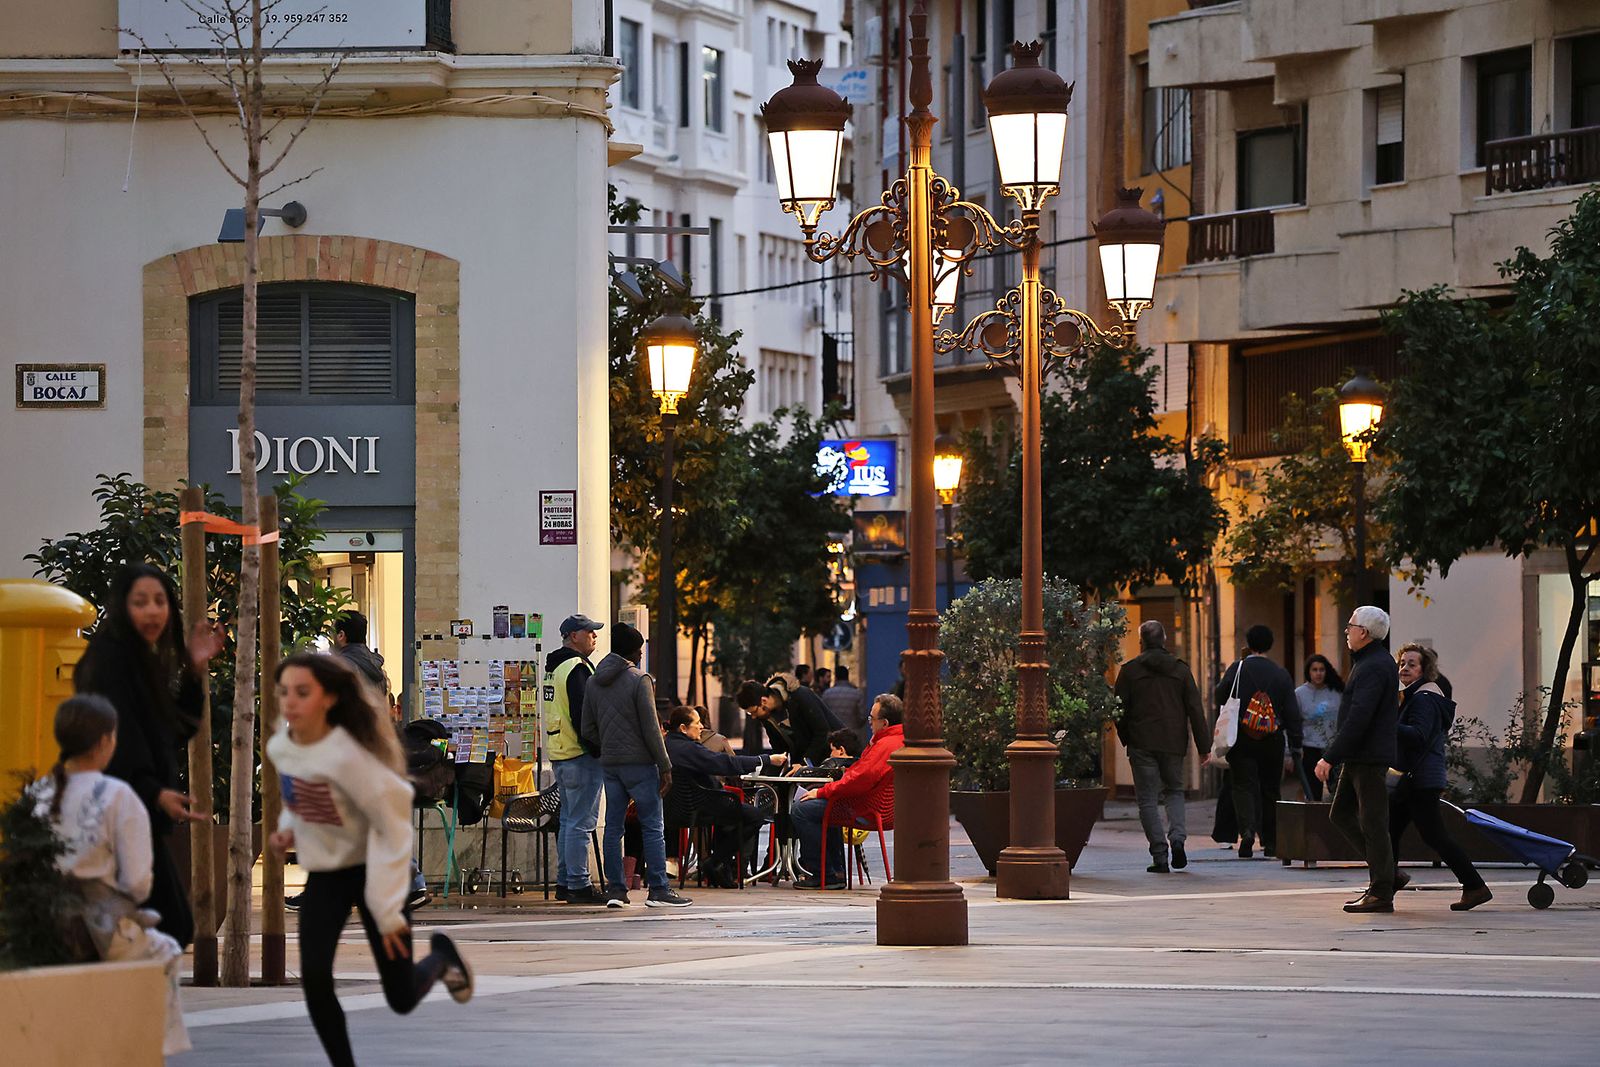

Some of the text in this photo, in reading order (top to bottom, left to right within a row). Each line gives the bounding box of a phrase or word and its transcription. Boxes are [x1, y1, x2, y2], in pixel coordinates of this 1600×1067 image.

[198, 14, 226, 24] Calle
[284, 14, 303, 23] 959
[306, 14, 326, 23] 247
[328, 13, 349, 23] 352
[45, 372, 77, 381] CALLE
[33, 386, 89, 400] BOCAS
[543, 506, 573, 514] PROTEGIDO
[543, 520, 573, 528] 24 HORAS
